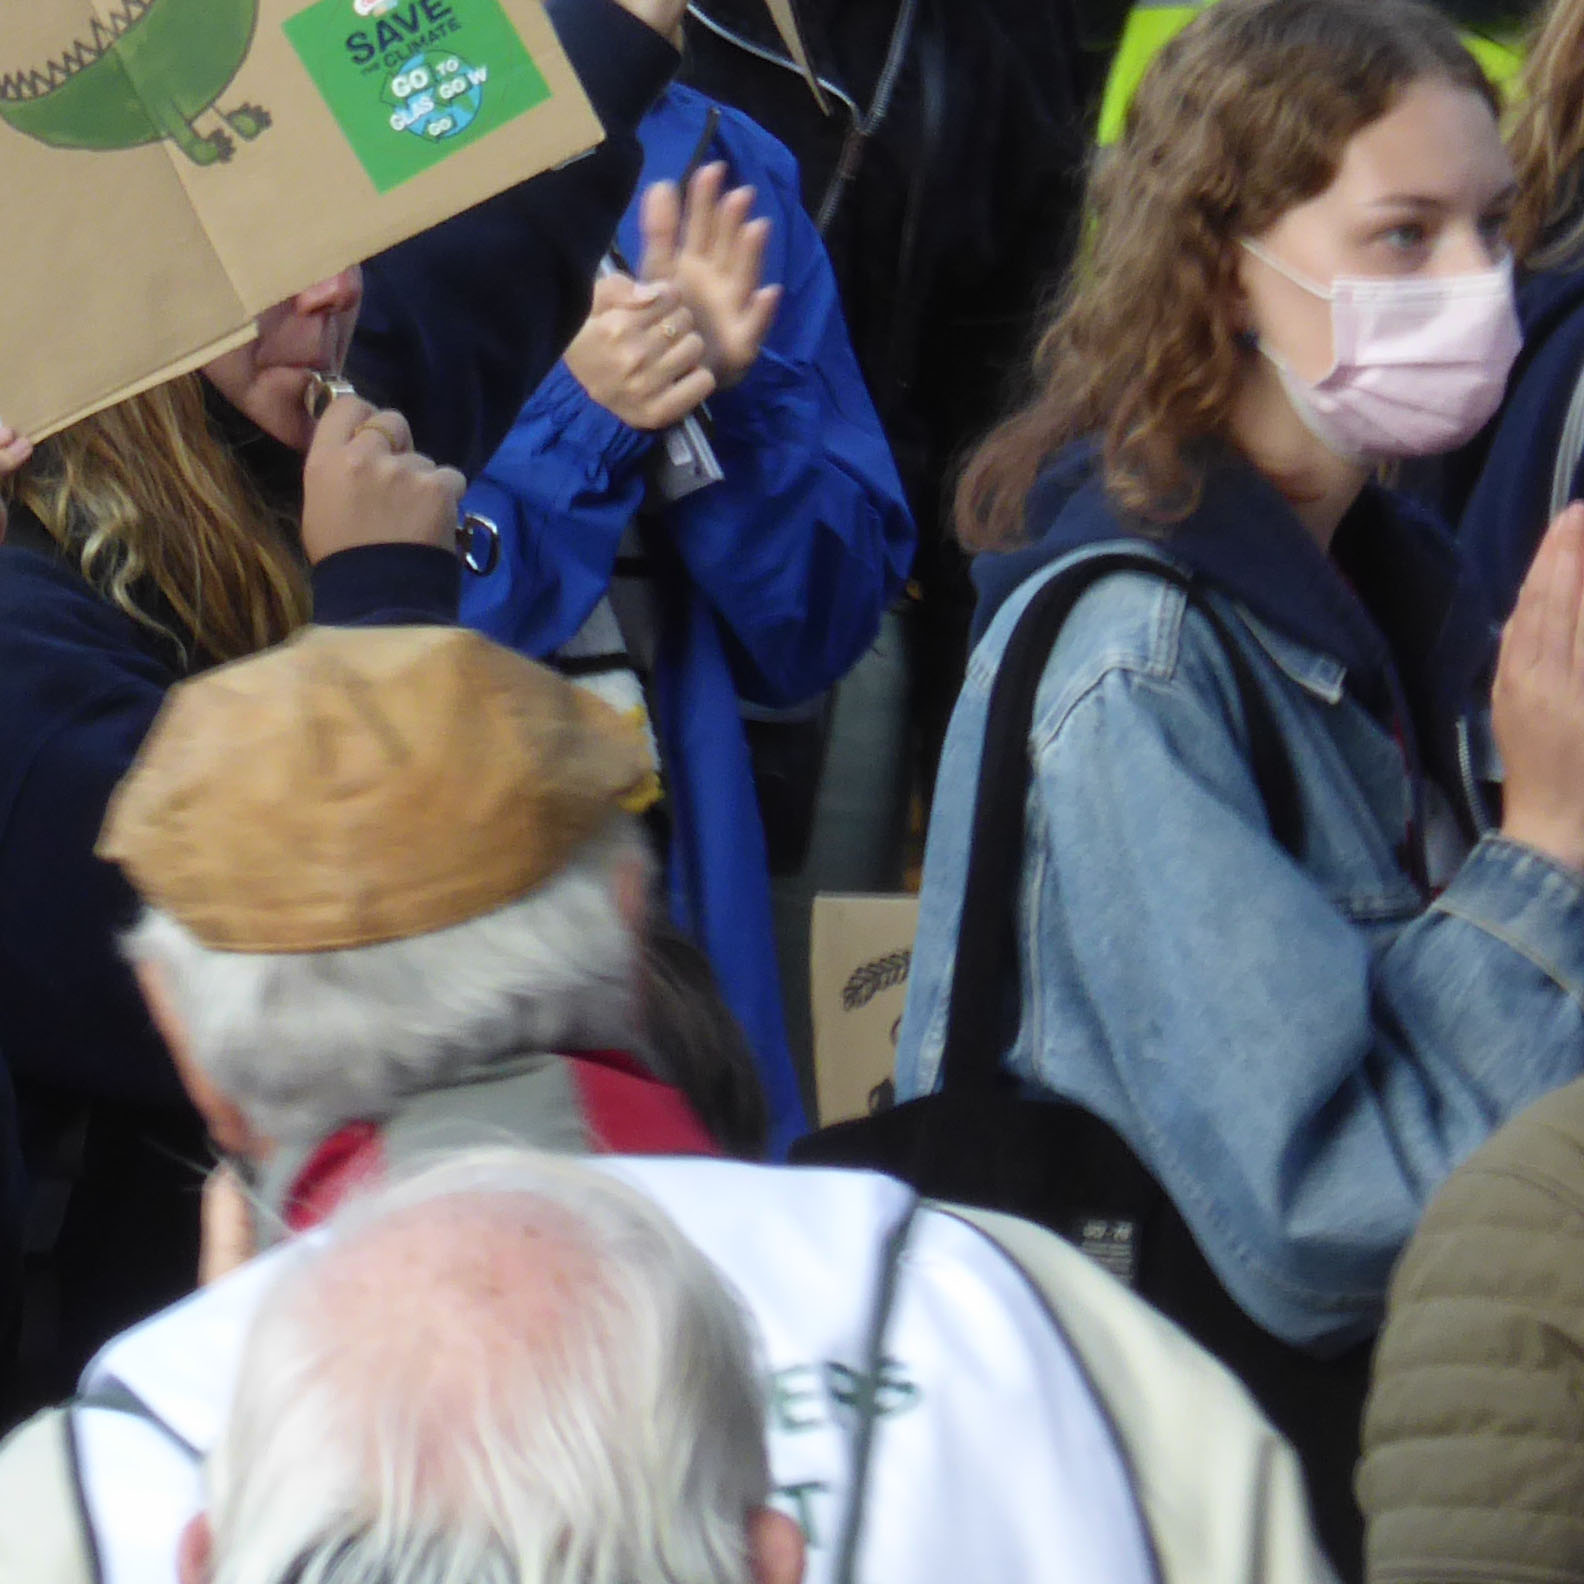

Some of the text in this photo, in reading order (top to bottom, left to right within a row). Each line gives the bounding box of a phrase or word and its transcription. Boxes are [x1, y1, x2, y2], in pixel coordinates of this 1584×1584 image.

[382, 16, 463, 69] CLIMATE
[391, 56, 460, 99] GO TO
